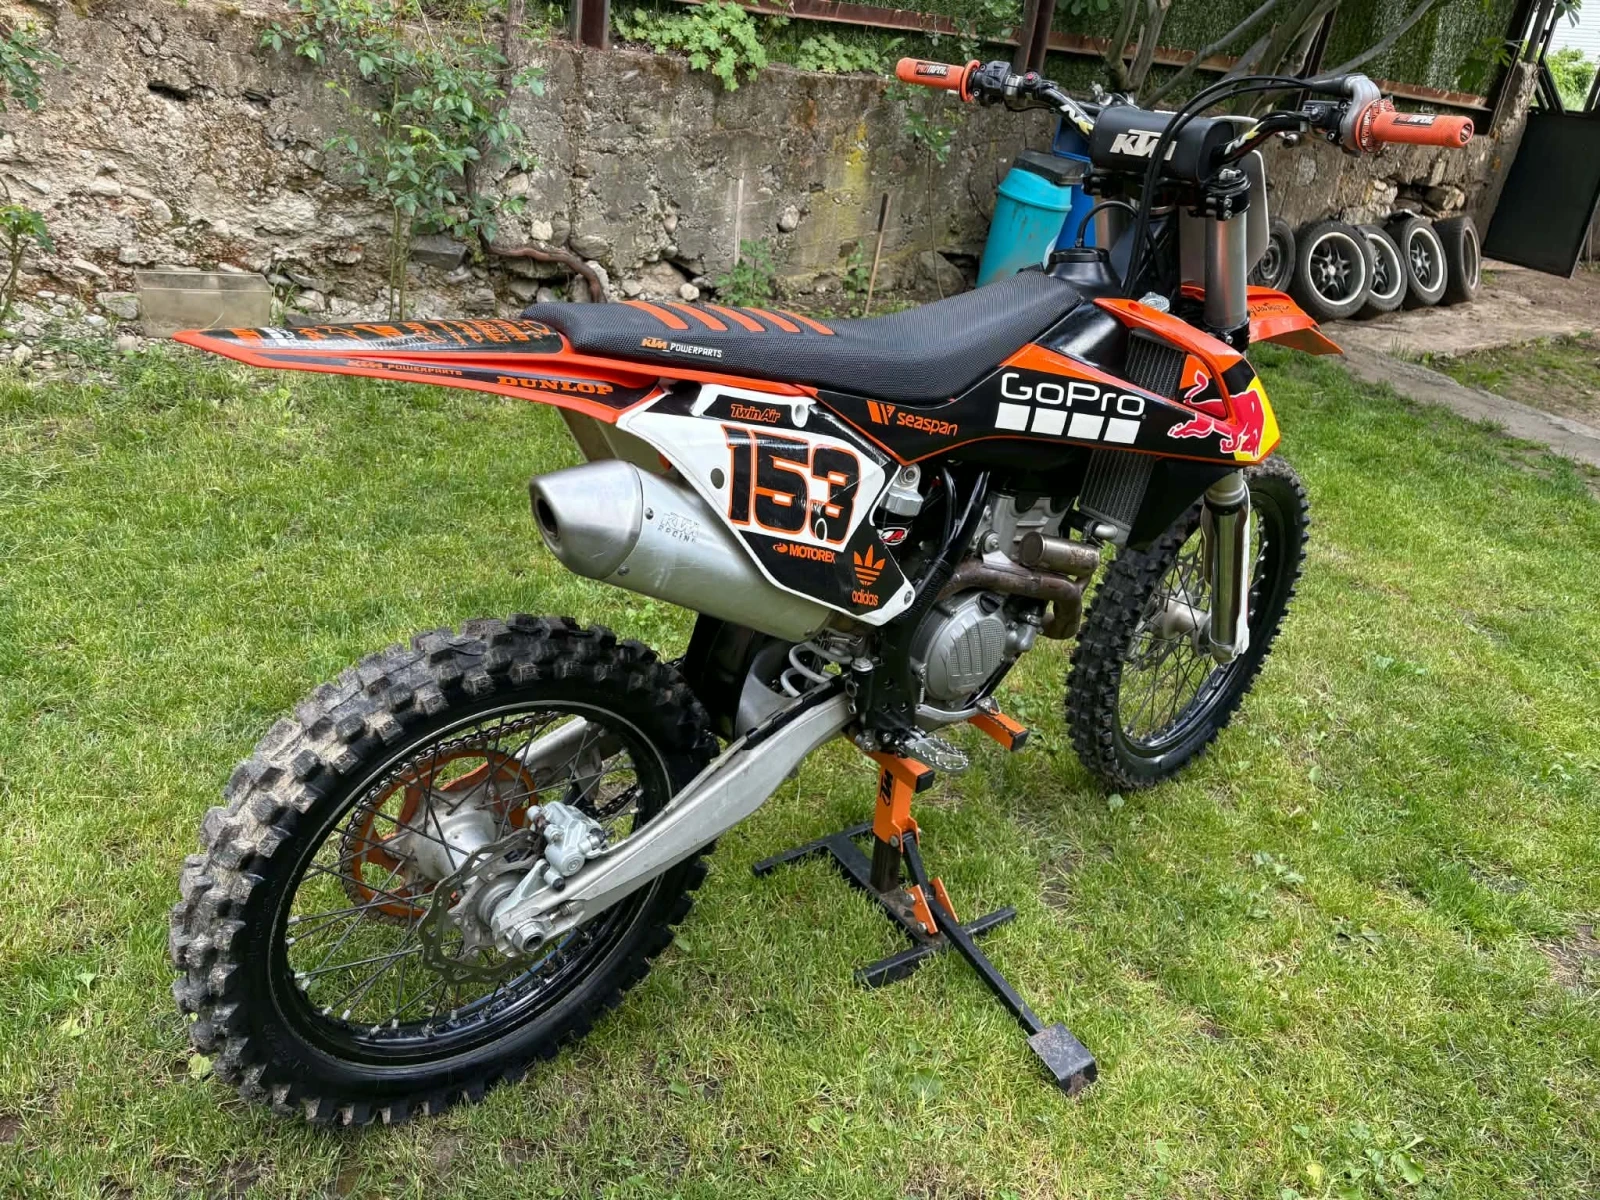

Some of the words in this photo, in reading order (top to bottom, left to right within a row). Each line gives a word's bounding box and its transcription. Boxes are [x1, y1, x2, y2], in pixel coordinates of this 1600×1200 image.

[1109, 128, 1177, 161] KTM
[641, 336, 668, 350] KTM
[670, 342, 722, 358] POWERPARTS
[387, 364, 463, 376] POWERPARTS
[496, 375, 613, 396] DUNLOP
[1001, 373, 1146, 416] GoPro
[731, 403, 761, 420] Twin
[760, 408, 781, 423] Air
[896, 411, 958, 437] seaspan
[720, 424, 861, 546] 153
[789, 543, 836, 564] MOTOREX
[851, 588, 879, 607] adidas
